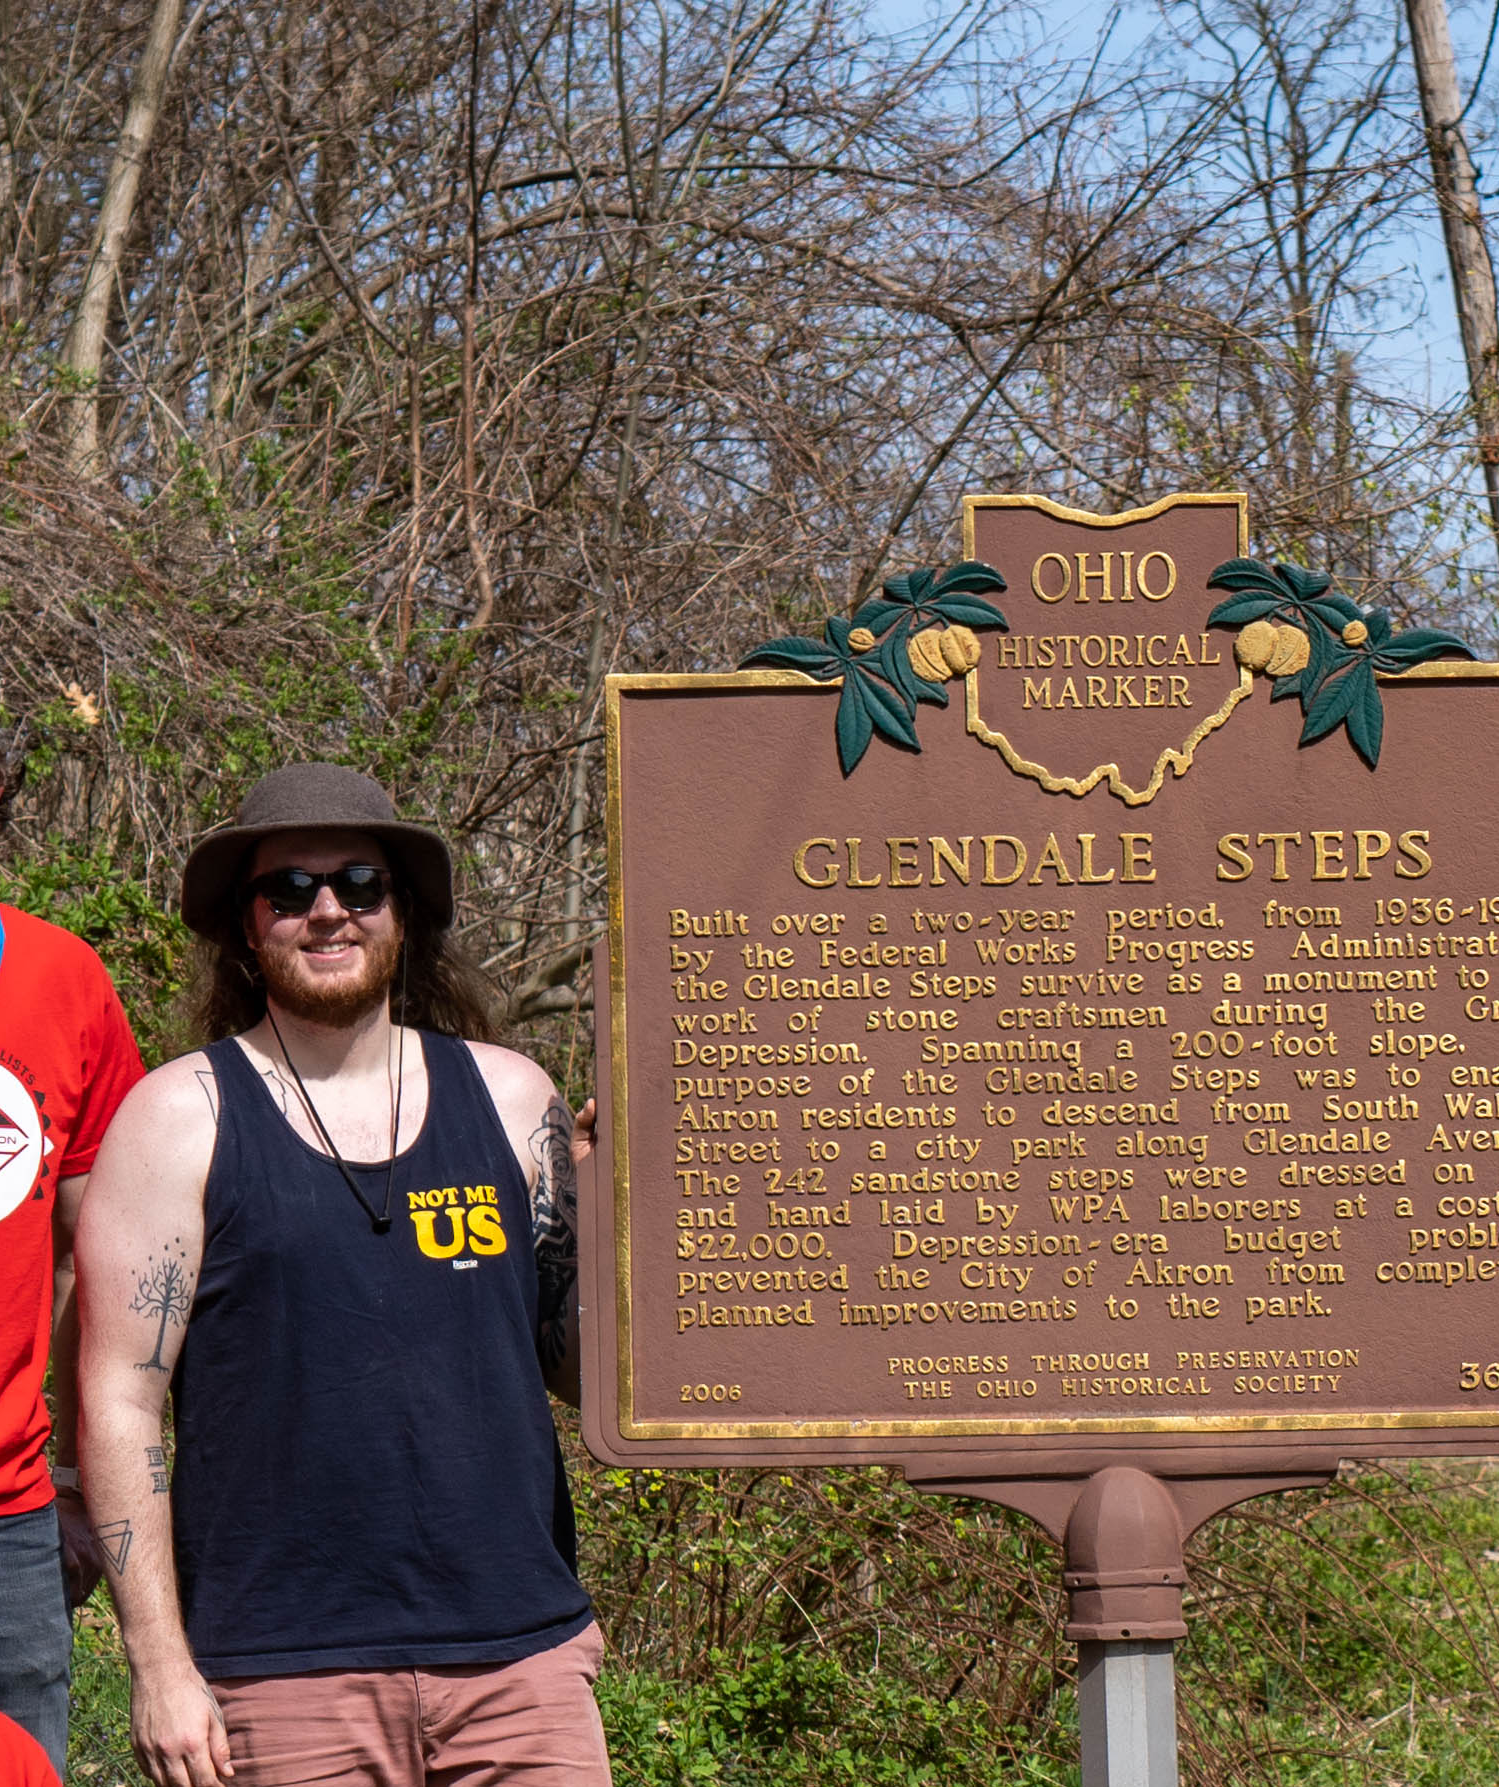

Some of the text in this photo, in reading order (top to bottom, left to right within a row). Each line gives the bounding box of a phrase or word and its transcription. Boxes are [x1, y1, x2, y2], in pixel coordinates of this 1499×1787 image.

[1032, 552, 1178, 602] OHIO
[998, 634, 1222, 667] HISTORICAL
[1022, 675, 1190, 709] MARKER
[793, 829, 1433, 887] GLENDALE STEPS
[670, 909, 750, 936] Built
[771, 912, 846, 934] over
[870, 914, 886, 933] a
[913, 909, 1076, 933] two-year
[1107, 903, 1227, 933] period,
[1262, 900, 1342, 927] from
[671, 944, 713, 974] by
[742, 944, 795, 968] the
[822, 940, 947, 967] Federal
[976, 936, 1078, 963] Works
[1107, 936, 1255, 969] Progress
[673, 976, 729, 1000] the
[743, 973, 891, 999] Glendale
[910, 971, 998, 1000] Steps
[1020, 971, 1145, 995] survive
[1167, 972, 1204, 992] as
[1223, 972, 1243, 992] a
[1265, 964, 1438, 992] monument
[1458, 966, 1491, 989] to
[676, 1008, 757, 1032] work
[787, 1008, 823, 1030] of
[866, 1008, 958, 1031] stone
[998, 1002, 1166, 1029] craftsmen
[1211, 1000, 1329, 1030] during
[1374, 997, 1427, 1022] the
[675, 1038, 868, 1070] Depression.
[921, 1035, 1082, 1067] Spanning
[1118, 1041, 1134, 1058] a
[1170, 1029, 1339, 1057] 200-foot
[1370, 1029, 1466, 1060] slope,
[675, 1077, 811, 1102] purpose
[838, 1069, 876, 1095] of
[902, 1069, 958, 1094] the
[985, 1067, 1140, 1094] Glendale
[1170, 1066, 1261, 1095] Steps
[1294, 1068, 1357, 1088] was
[1386, 1064, 1421, 1087] to
[677, 1104, 778, 1130] Akron
[802, 1104, 958, 1128] residents
[982, 1104, 1017, 1126] to
[1042, 1099, 1179, 1124] descend
[1212, 1094, 1290, 1120] from
[1323, 1096, 1420, 1120] South
[676, 1136, 782, 1163] Street
[806, 1139, 841, 1160] to
[868, 1141, 886, 1160] a
[916, 1133, 981, 1163] city
[1011, 1132, 1086, 1164] park
[1116, 1130, 1210, 1163] along
[1243, 1128, 1390, 1154] Glendale
[675, 1170, 740, 1196] The
[763, 1168, 827, 1192] 242
[850, 1168, 1022, 1192] sandstone
[1048, 1168, 1134, 1192] steps
[1166, 1168, 1246, 1187] were
[1279, 1160, 1406, 1185] dressed
[1434, 1164, 1475, 1183] on
[406, 1185, 499, 1210] NOT ME
[676, 1202, 738, 1228] and
[766, 1200, 851, 1226] hand
[880, 1200, 946, 1224] laid
[975, 1197, 1020, 1229] by
[1050, 1194, 1131, 1221] WPA
[1160, 1194, 1302, 1221] laborers
[1334, 1196, 1366, 1218] at
[1394, 1198, 1414, 1216] a
[409, 1205, 508, 1259] US
[678, 1231, 833, 1261] $22,000.
[894, 1230, 1169, 1262] Depression-era
[1224, 1226, 1342, 1259] budget
[678, 1264, 849, 1296] prevented
[875, 1264, 931, 1288] the
[960, 1261, 1034, 1291] City
[1063, 1261, 1098, 1286] of
[1126, 1258, 1234, 1285] Akron
[1265, 1257, 1346, 1283] from
[678, 1288, 1332, 1331] planned improvements to the park.
[888, 1349, 1358, 1375] PROGRESS THROUGH PRESERVATION
[680, 1384, 742, 1403] 2006
[904, 1375, 1342, 1398] THE OHIO HISTORICAL SOCIETY
